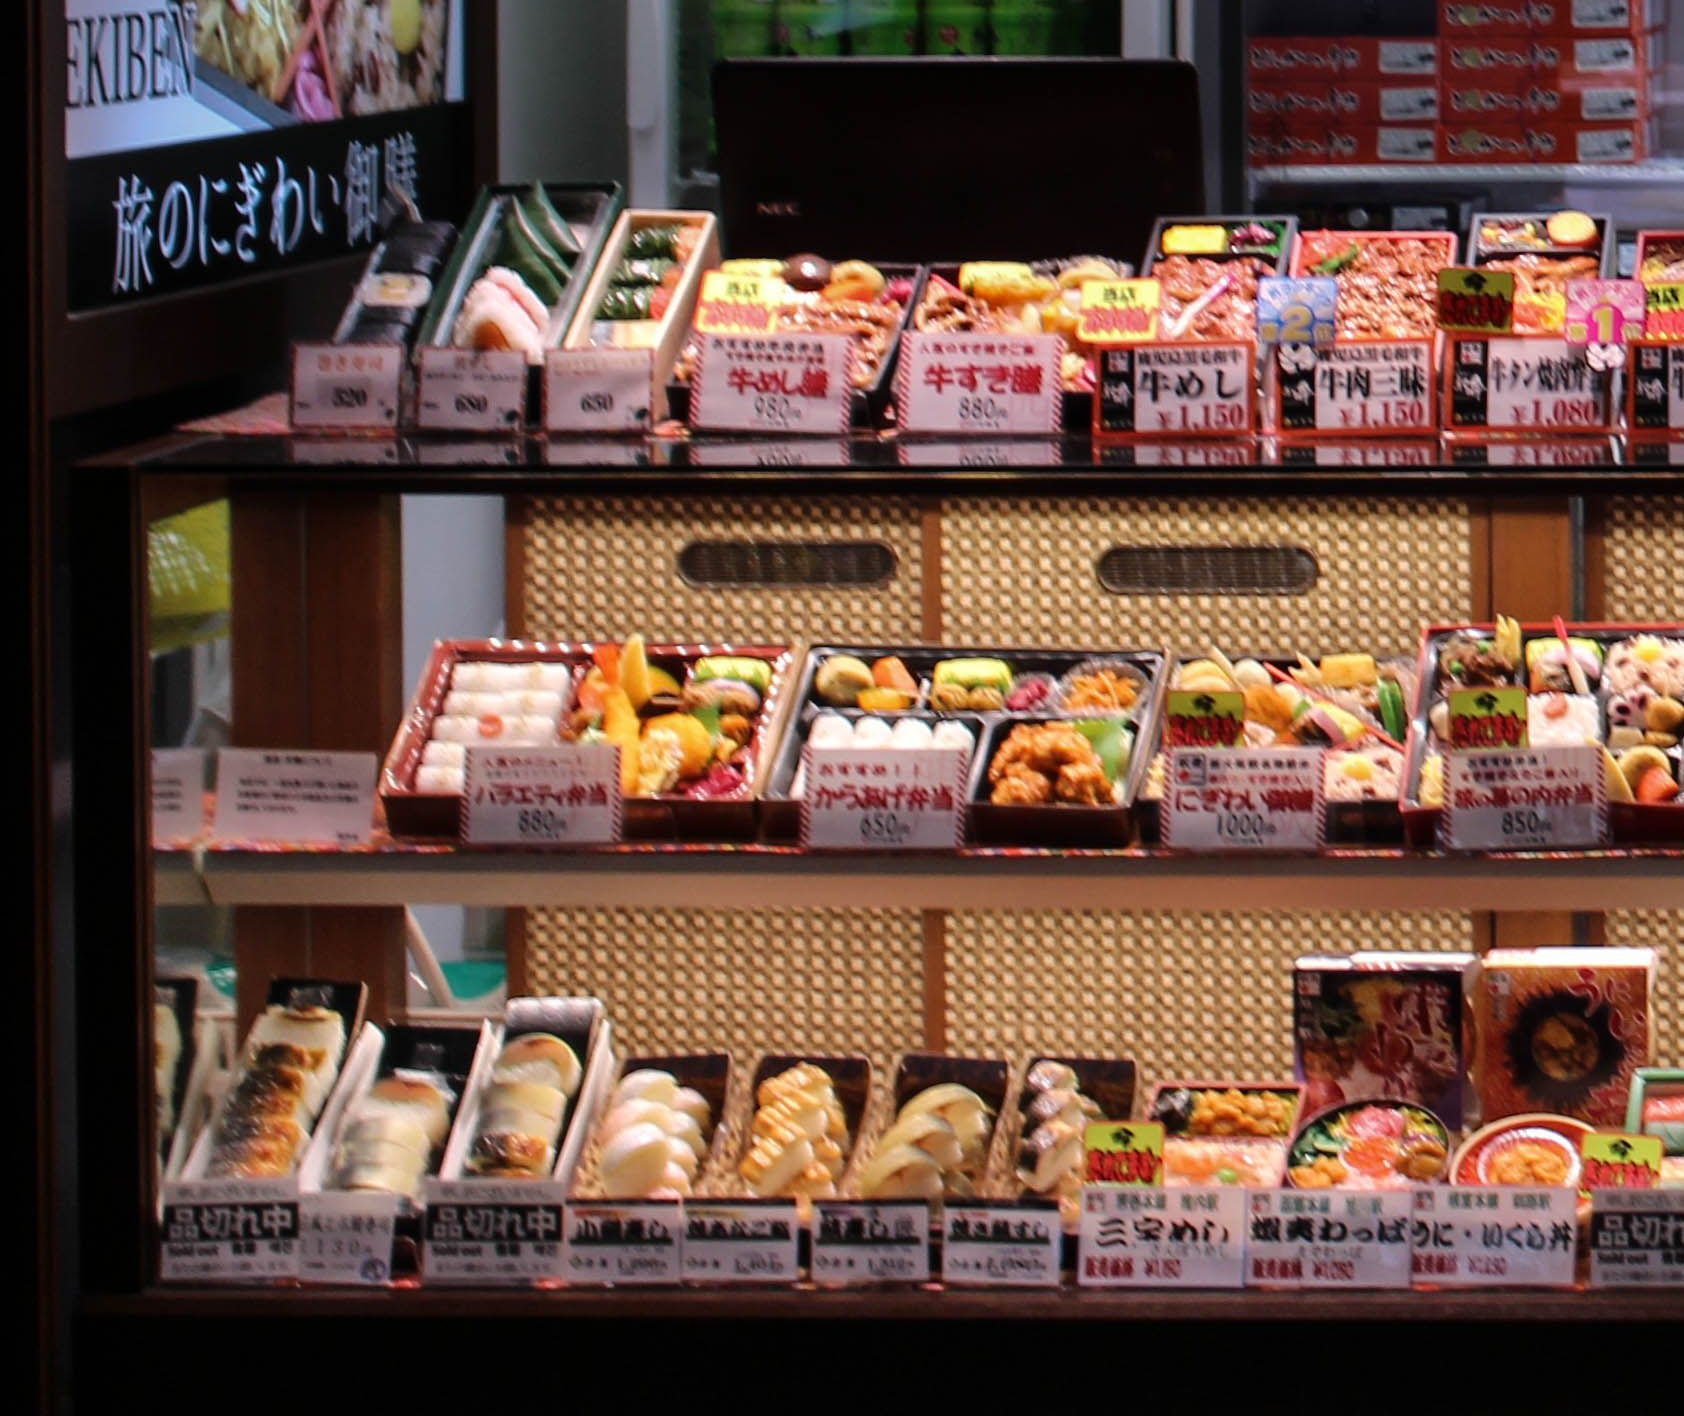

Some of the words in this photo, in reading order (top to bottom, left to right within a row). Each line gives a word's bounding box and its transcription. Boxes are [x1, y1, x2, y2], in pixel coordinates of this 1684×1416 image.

[66, 1, 196, 109] EKIBEN
[924, 363, 1043, 395] 牛すき膳
[1139, 369, 1240, 404] 牛めし
[1158, 403, 1244, 430] ¥1,150
[1338, 401, 1425, 428] ¥1,150
[814, 785, 953, 812] から揚げ弁当
[170, 1206, 293, 1238] 品切れ中
[433, 1207, 557, 1238] 品切れ中
